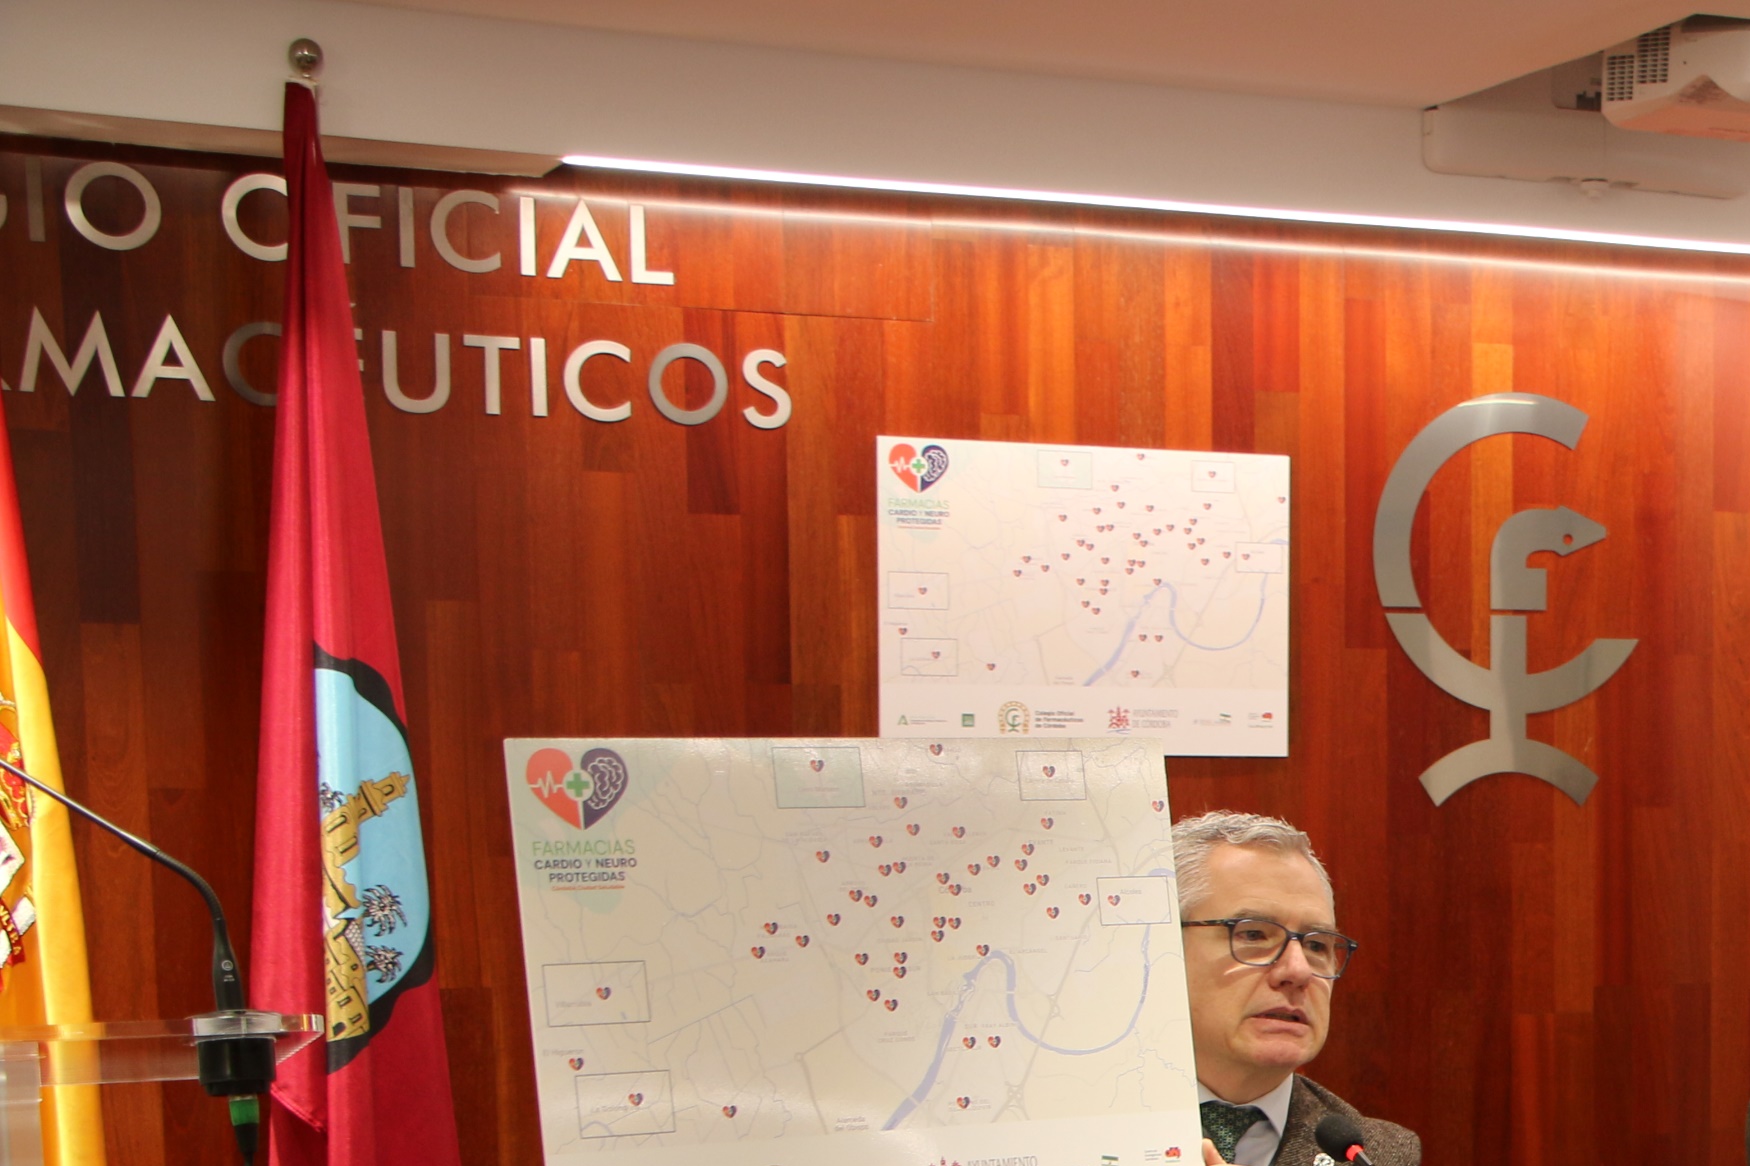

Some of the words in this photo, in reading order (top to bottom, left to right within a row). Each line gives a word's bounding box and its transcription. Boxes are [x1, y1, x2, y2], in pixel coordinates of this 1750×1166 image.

[532, 839, 636, 857] FARMACIAS
[534, 859, 582, 870] CARDIO
[585, 859, 592, 868] Y
[595, 857, 637, 868] NEURO
[549, 871, 625, 883] PROTEGIDAS
